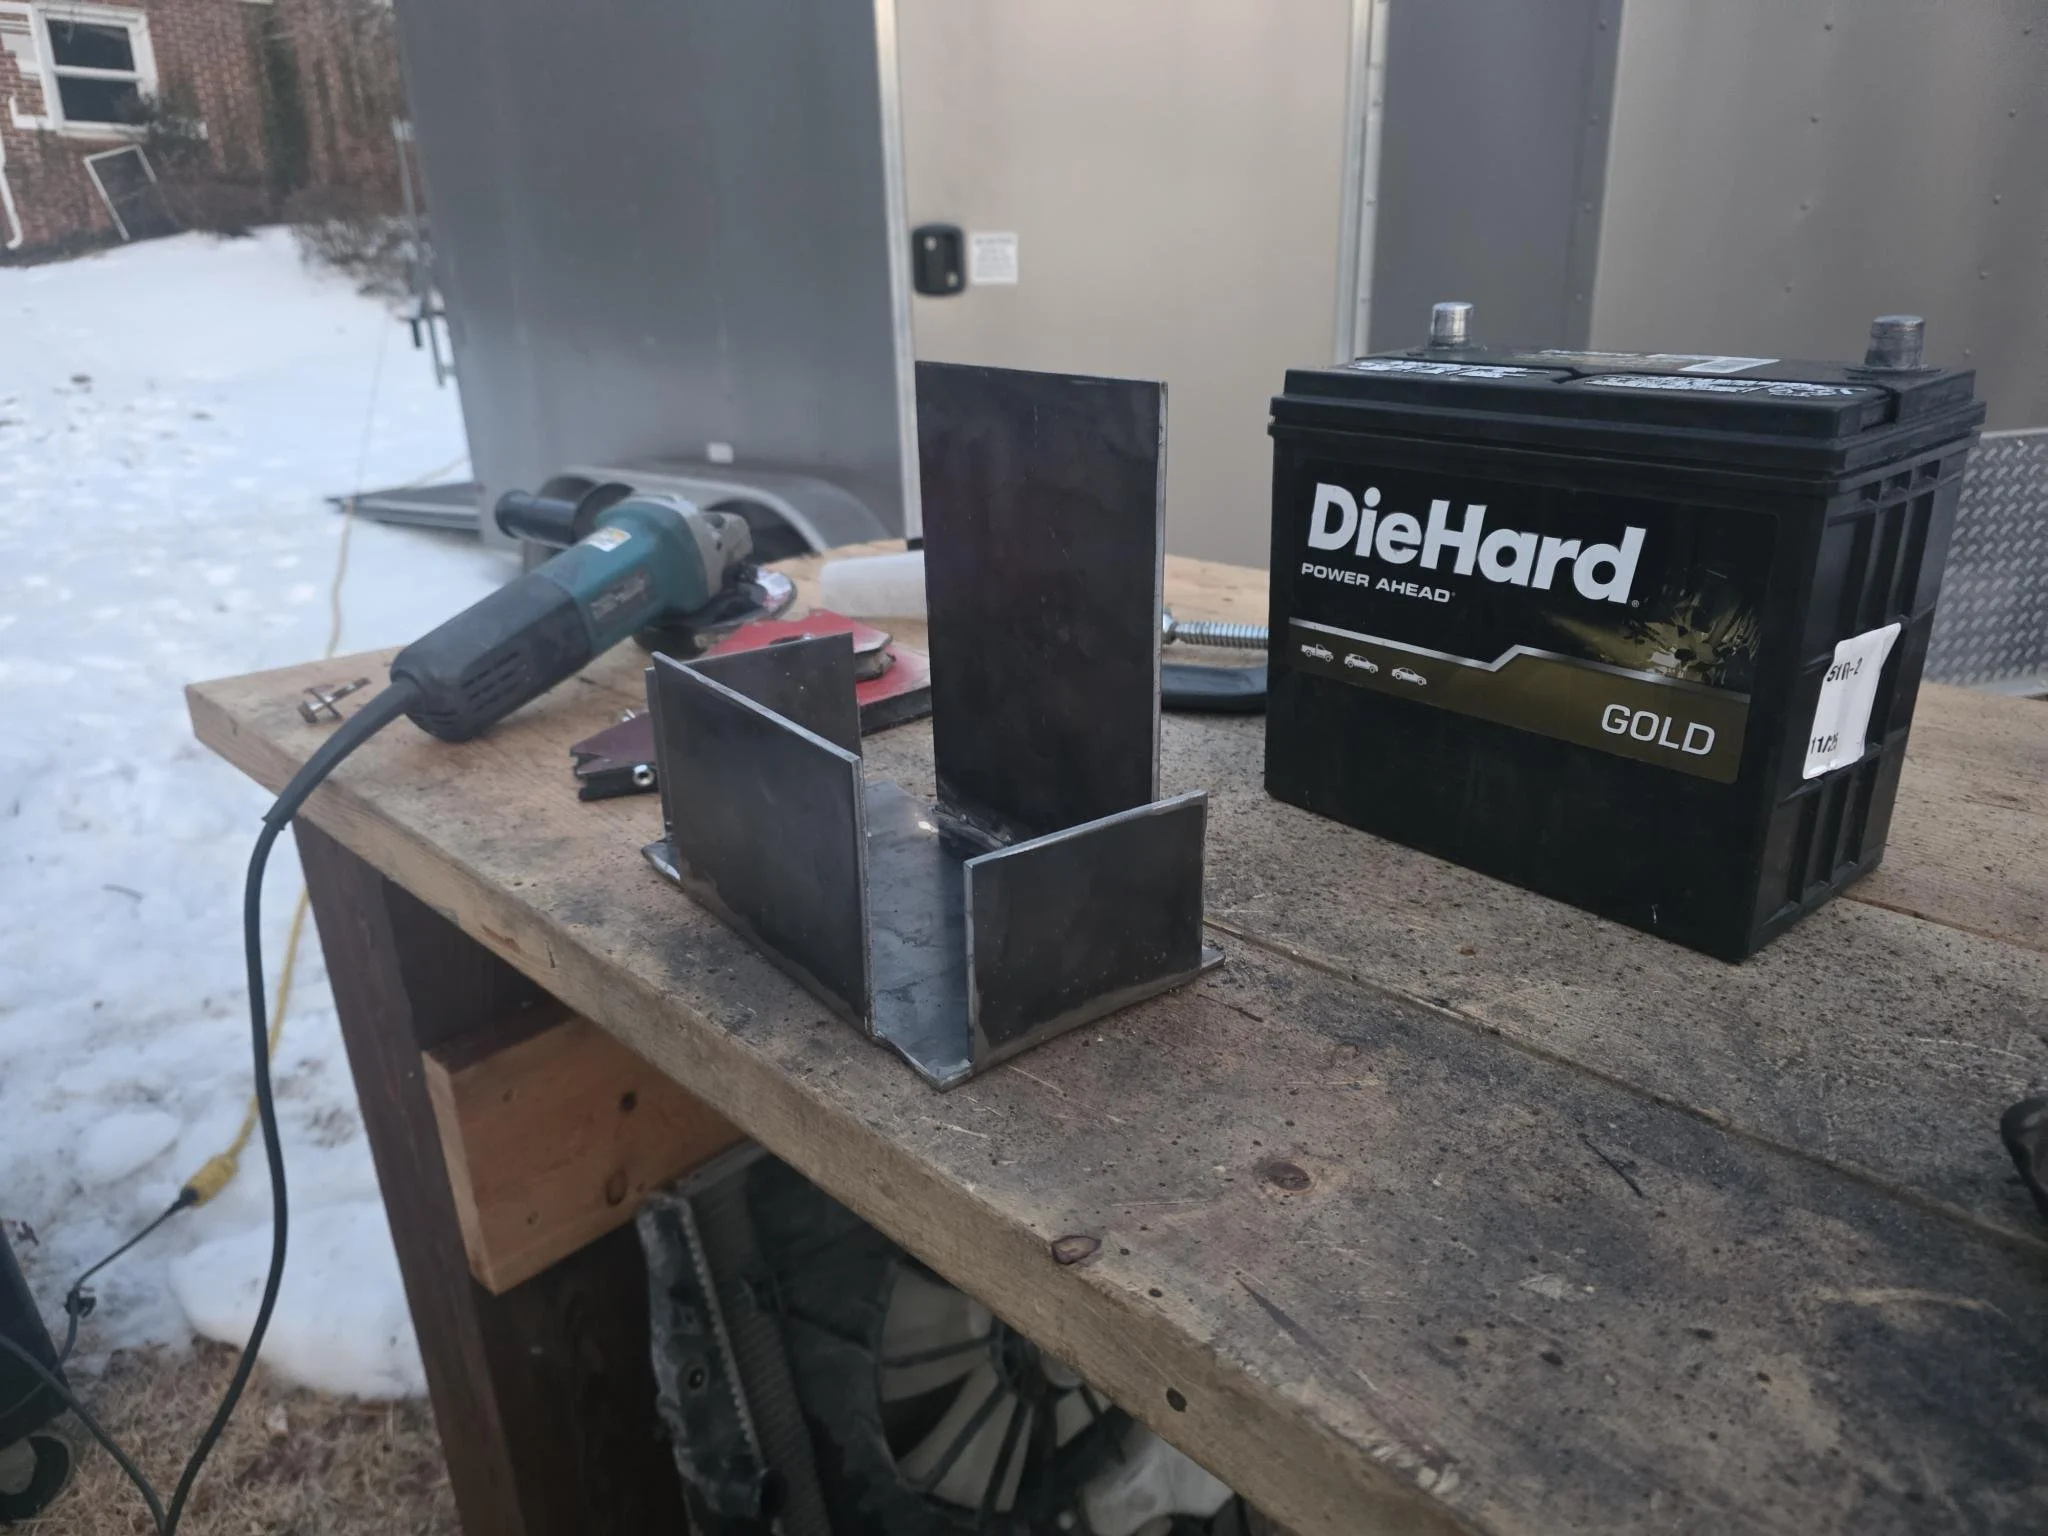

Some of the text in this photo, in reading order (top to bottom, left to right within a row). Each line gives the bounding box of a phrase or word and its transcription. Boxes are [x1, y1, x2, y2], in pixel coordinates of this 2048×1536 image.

[1308, 482, 1646, 604] DieHard
[1301, 562, 1451, 603] POWER AHEAD
[1601, 703, 1716, 755] GOLD
